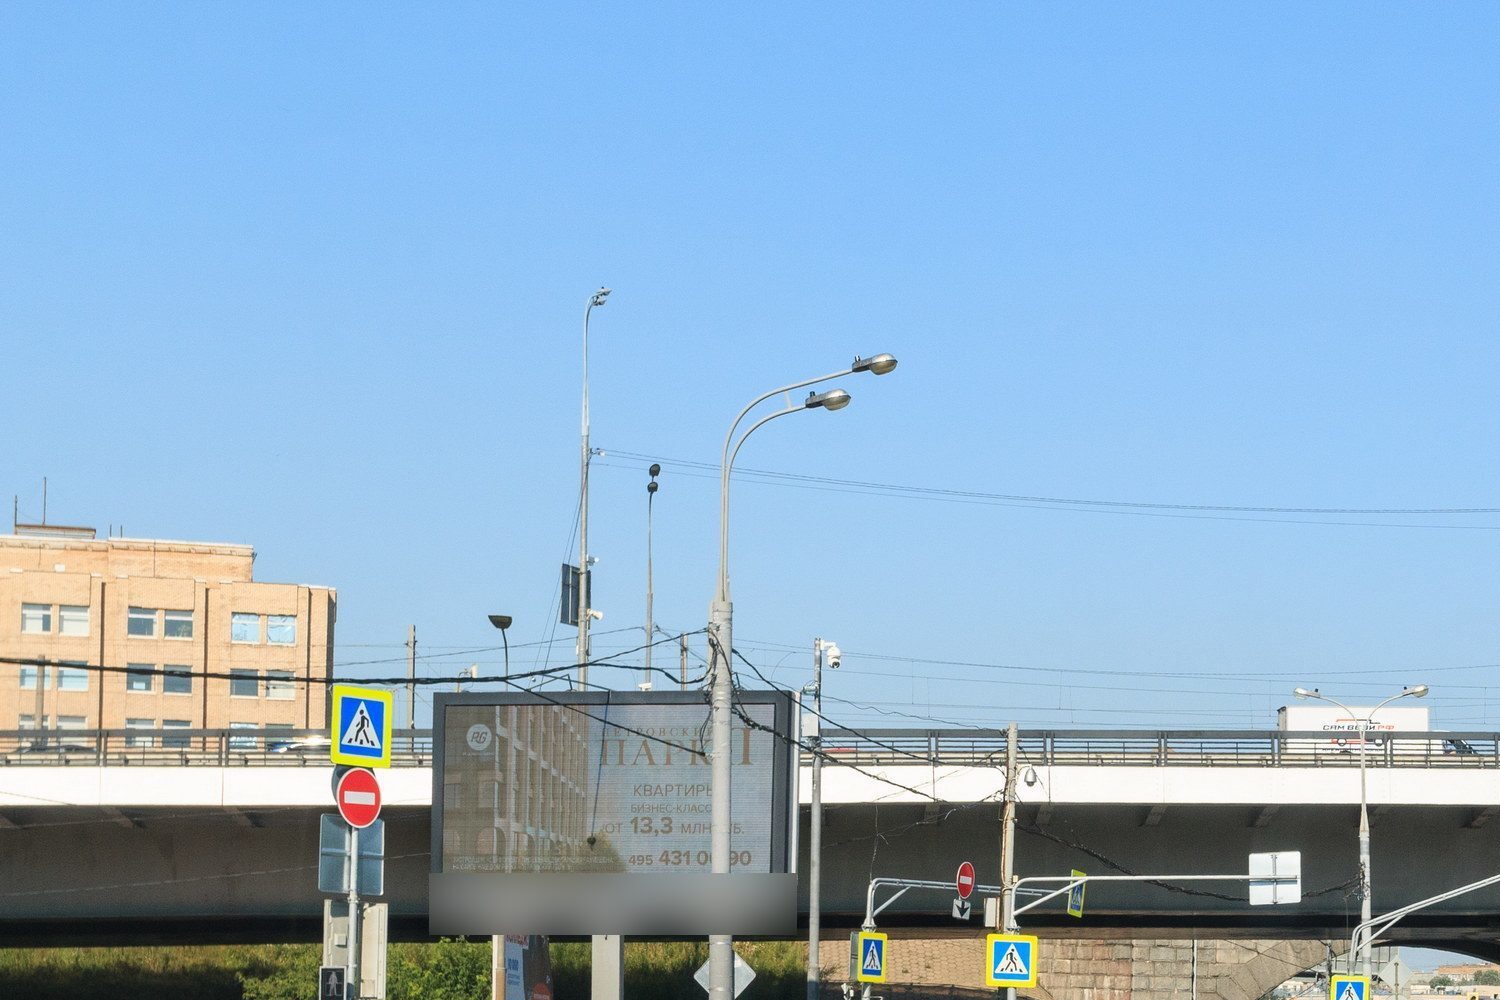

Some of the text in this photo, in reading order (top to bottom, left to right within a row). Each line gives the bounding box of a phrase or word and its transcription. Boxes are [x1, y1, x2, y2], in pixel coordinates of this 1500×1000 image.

[630, 816, 673, 837] 13,3
[629, 854, 653, 866] 495
[659, 850, 690, 866] 431
